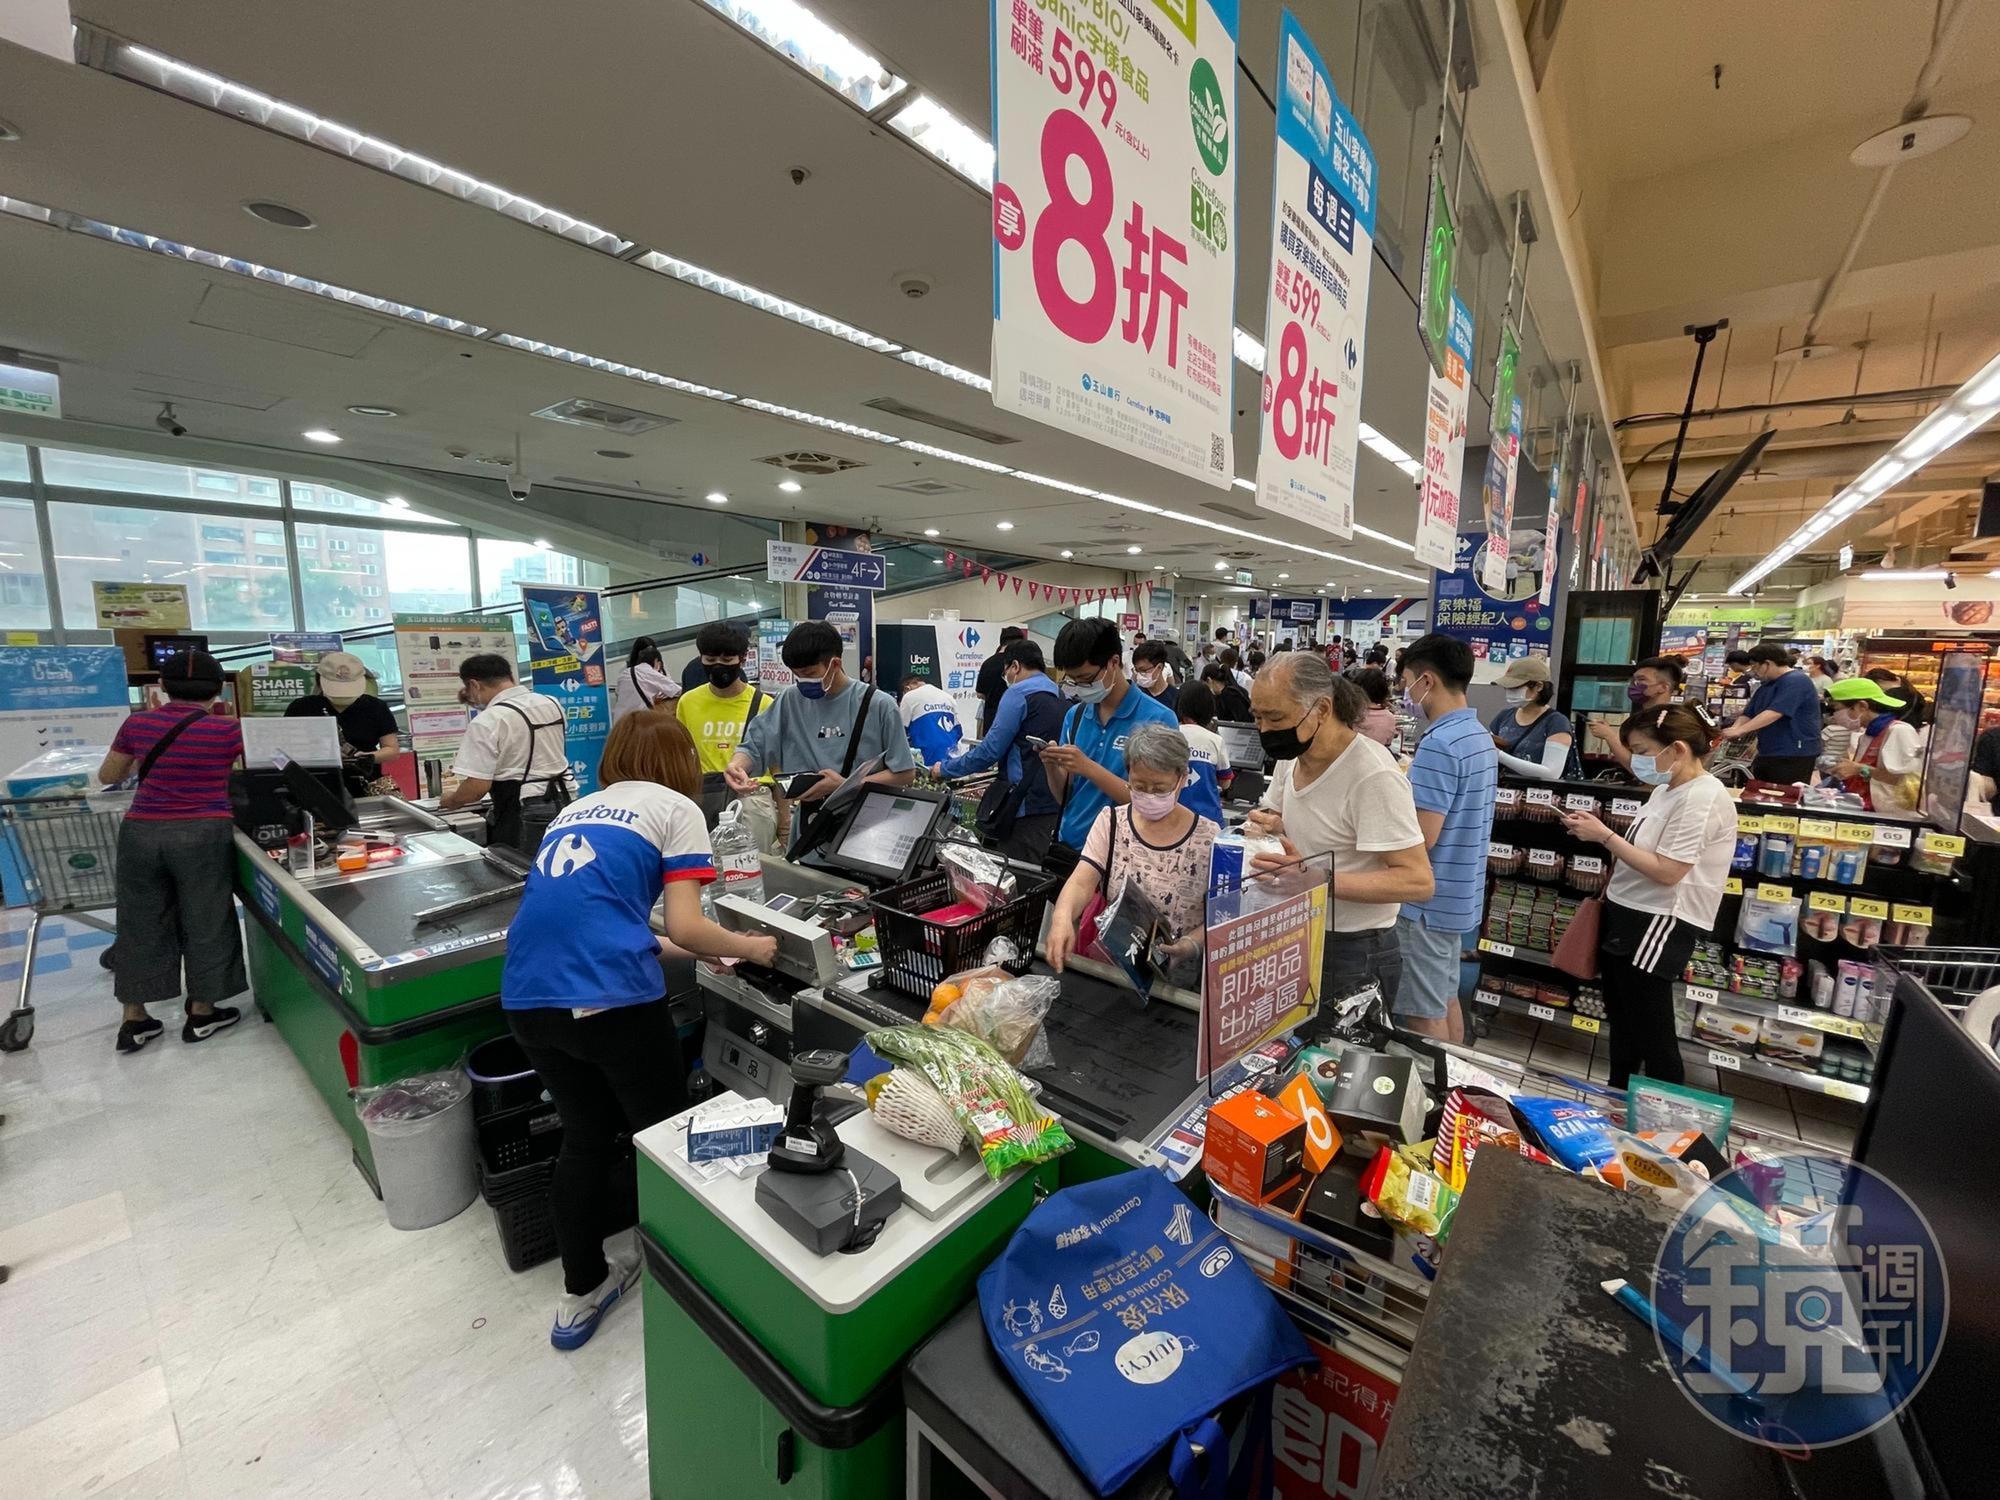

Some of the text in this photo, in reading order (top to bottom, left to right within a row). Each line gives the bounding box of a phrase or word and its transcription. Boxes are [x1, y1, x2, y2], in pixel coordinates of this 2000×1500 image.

[1011, 23, 1043, 75] 刷滿
[1049, 27, 1117, 129] 599
[1191, 166, 1227, 217] Carrefour
[1312, 175, 1351, 244] 每週三
[998, 197, 1021, 237] 享
[1191, 184, 1228, 252] BIO
[1033, 109, 1188, 369] 8折
[1290, 270, 1321, 328] 599
[1273, 321, 1338, 467] 8折
[1430, 446, 1445, 477] 399
[850, 561, 867, 578] 4F
[1438, 598, 1482, 611] 家樂福
[1437, 612, 1509, 626] 保險經紀人
[910, 654, 930, 665] Uber
[955, 652, 984, 660] Carrefour
[911, 665, 930, 675] Eats
[252, 679, 304, 690] SHARE
[924, 702, 954, 712] Carrefo
[1529, 792, 1550, 800] 269
[1569, 798, 1591, 807] 269
[1615, 803, 1638, 812] 269
[547, 804, 639, 829] arrefour
[1776, 821, 1796, 830] 199
[1813, 824, 1832, 833] 79
[1851, 829, 1872, 838] 89
[1883, 832, 1903, 841] 69
[1490, 846, 1510, 854] 269
[1934, 840, 1955, 849] 69
[1532, 853, 1552, 861] 269
[1577, 860, 1599, 868] 269
[725, 873, 744, 882] 6200
[1765, 889, 1784, 898] 65
[1817, 897, 1838, 906] 79
[1859, 903, 1879, 912] 79
[1903, 910, 1923, 919] 79
[341, 965, 353, 994] 15
[1220, 943, 1302, 1009] 即期品
[1219, 977, 1300, 1045] 出清區
[1578, 1019, 1594, 1028] 70
[1711, 1054, 1736, 1065] 399
[1100, 1196, 1142, 1229] Carrefour
[1081, 1244, 1165, 1300] 僅供店內使用
[1101, 1268, 1174, 1312] COOLING BAG
[1117, 1281, 1190, 1330] 保冷袋
[1120, 1337, 1175, 1375] JUICY!
